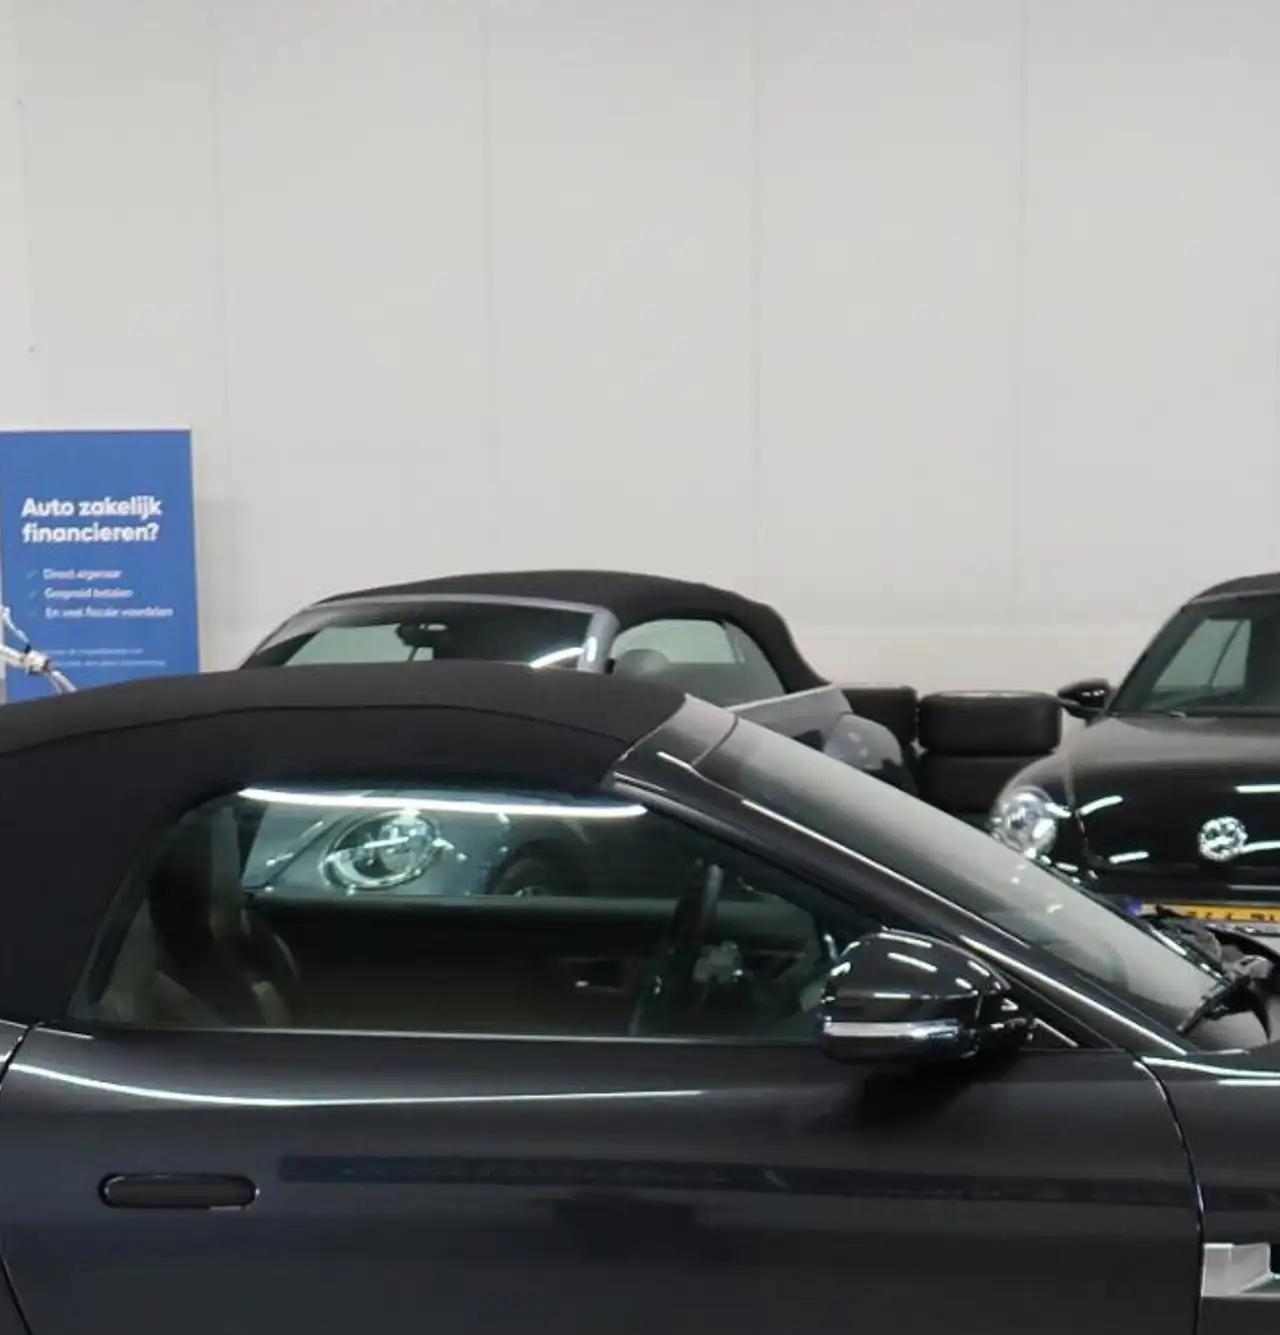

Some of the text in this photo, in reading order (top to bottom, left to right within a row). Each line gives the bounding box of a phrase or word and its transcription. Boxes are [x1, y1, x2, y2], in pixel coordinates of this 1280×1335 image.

[22, 495, 162, 521] Auto zakelijk
[22, 521, 159, 543] financieren?
